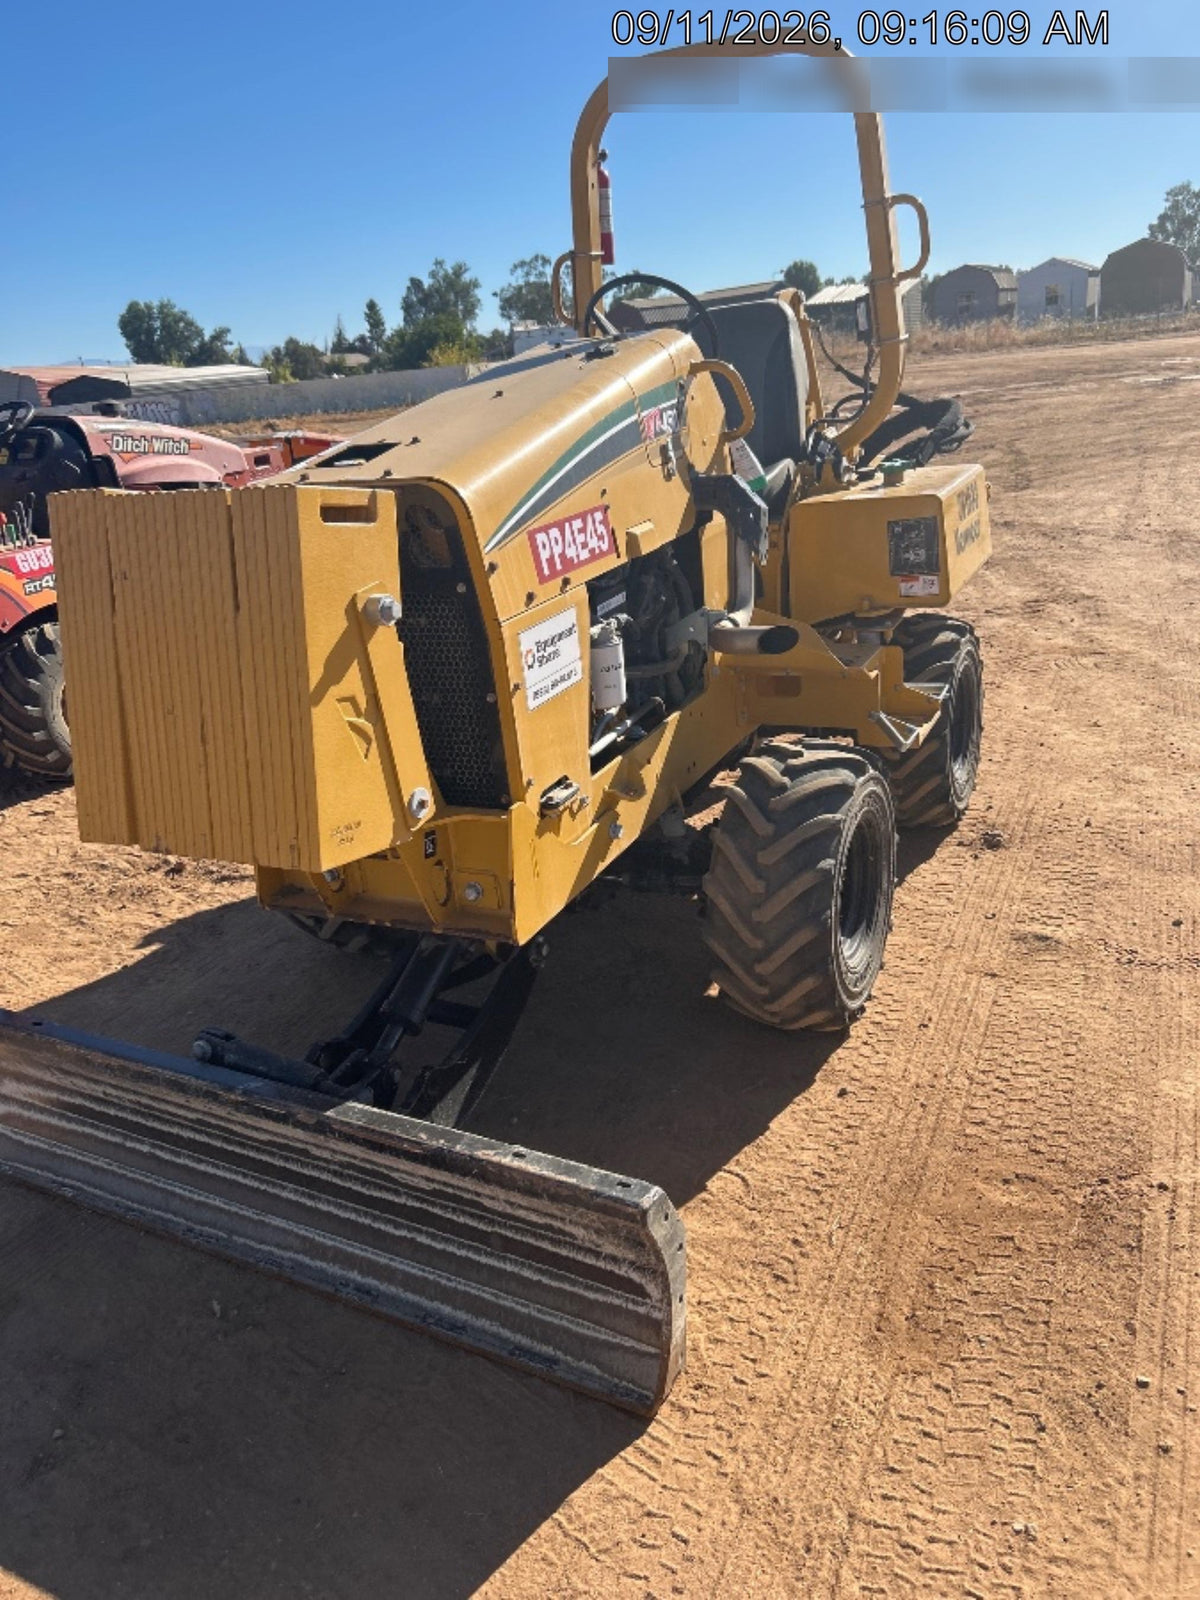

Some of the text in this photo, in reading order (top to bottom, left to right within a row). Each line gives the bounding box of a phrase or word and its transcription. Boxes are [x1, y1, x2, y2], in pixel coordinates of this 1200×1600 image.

[112, 434, 189, 455] Ditch Witch
[534, 510, 610, 577] PP4E45
[24, 573, 56, 594] RT4
